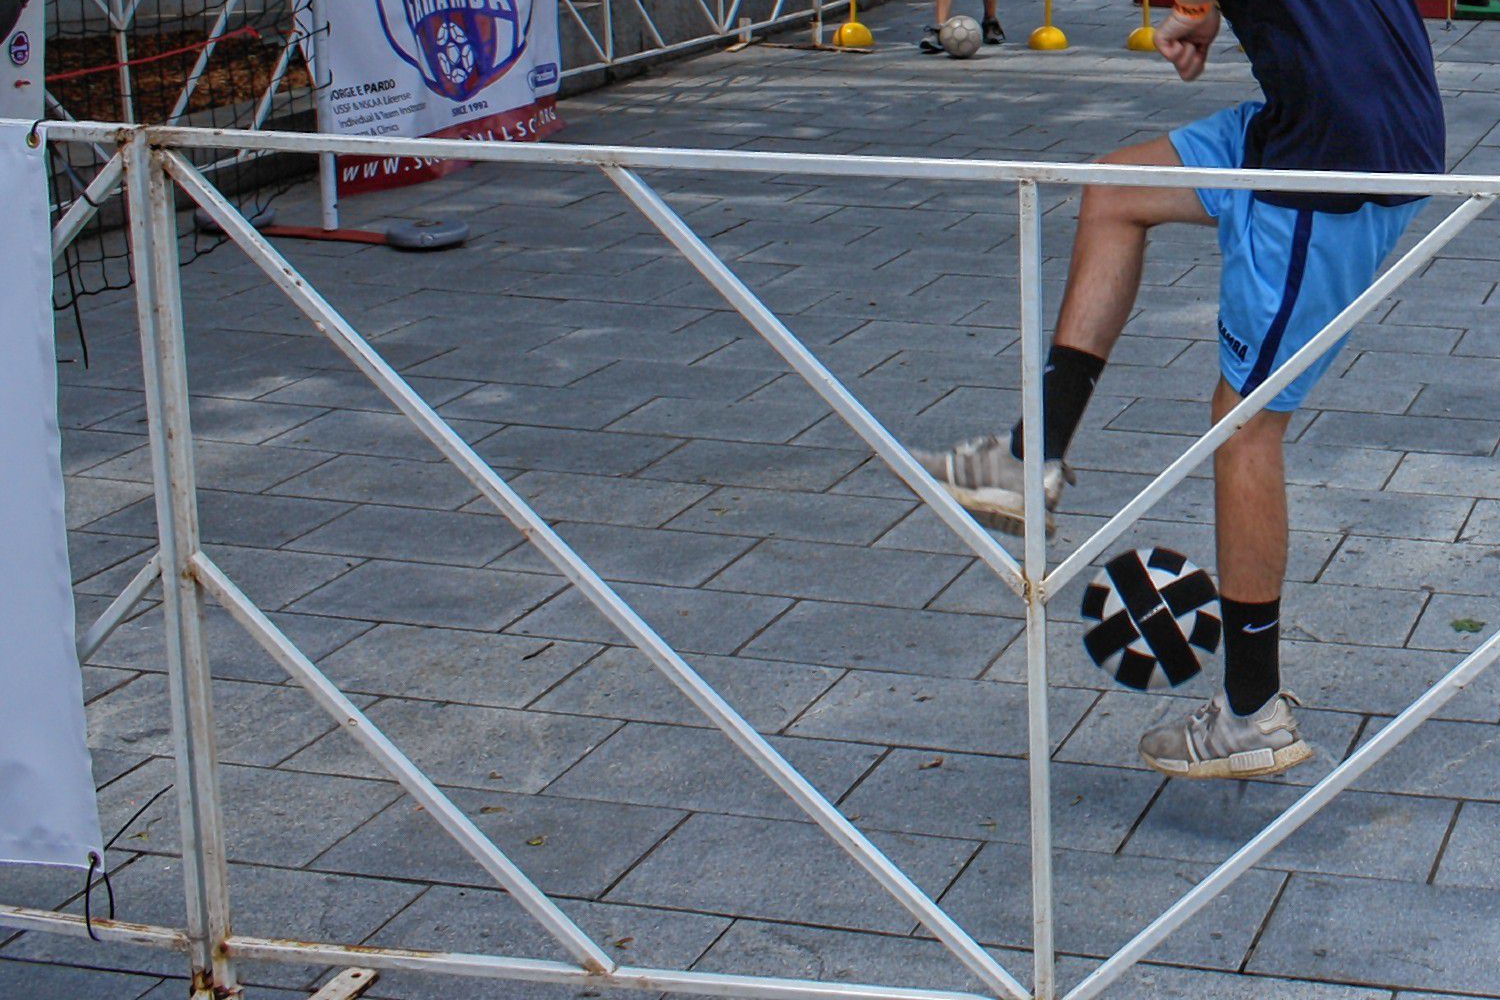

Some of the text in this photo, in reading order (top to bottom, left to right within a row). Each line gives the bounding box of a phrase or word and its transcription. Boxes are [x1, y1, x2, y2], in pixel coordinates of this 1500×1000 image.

[356, 85, 364, 96] E
[364, 78, 396, 95] PARDO
[333, 102, 351, 115] USSF
[452, 100, 489, 117] SINCE 1992
[338, 113, 373, 129] Individual
